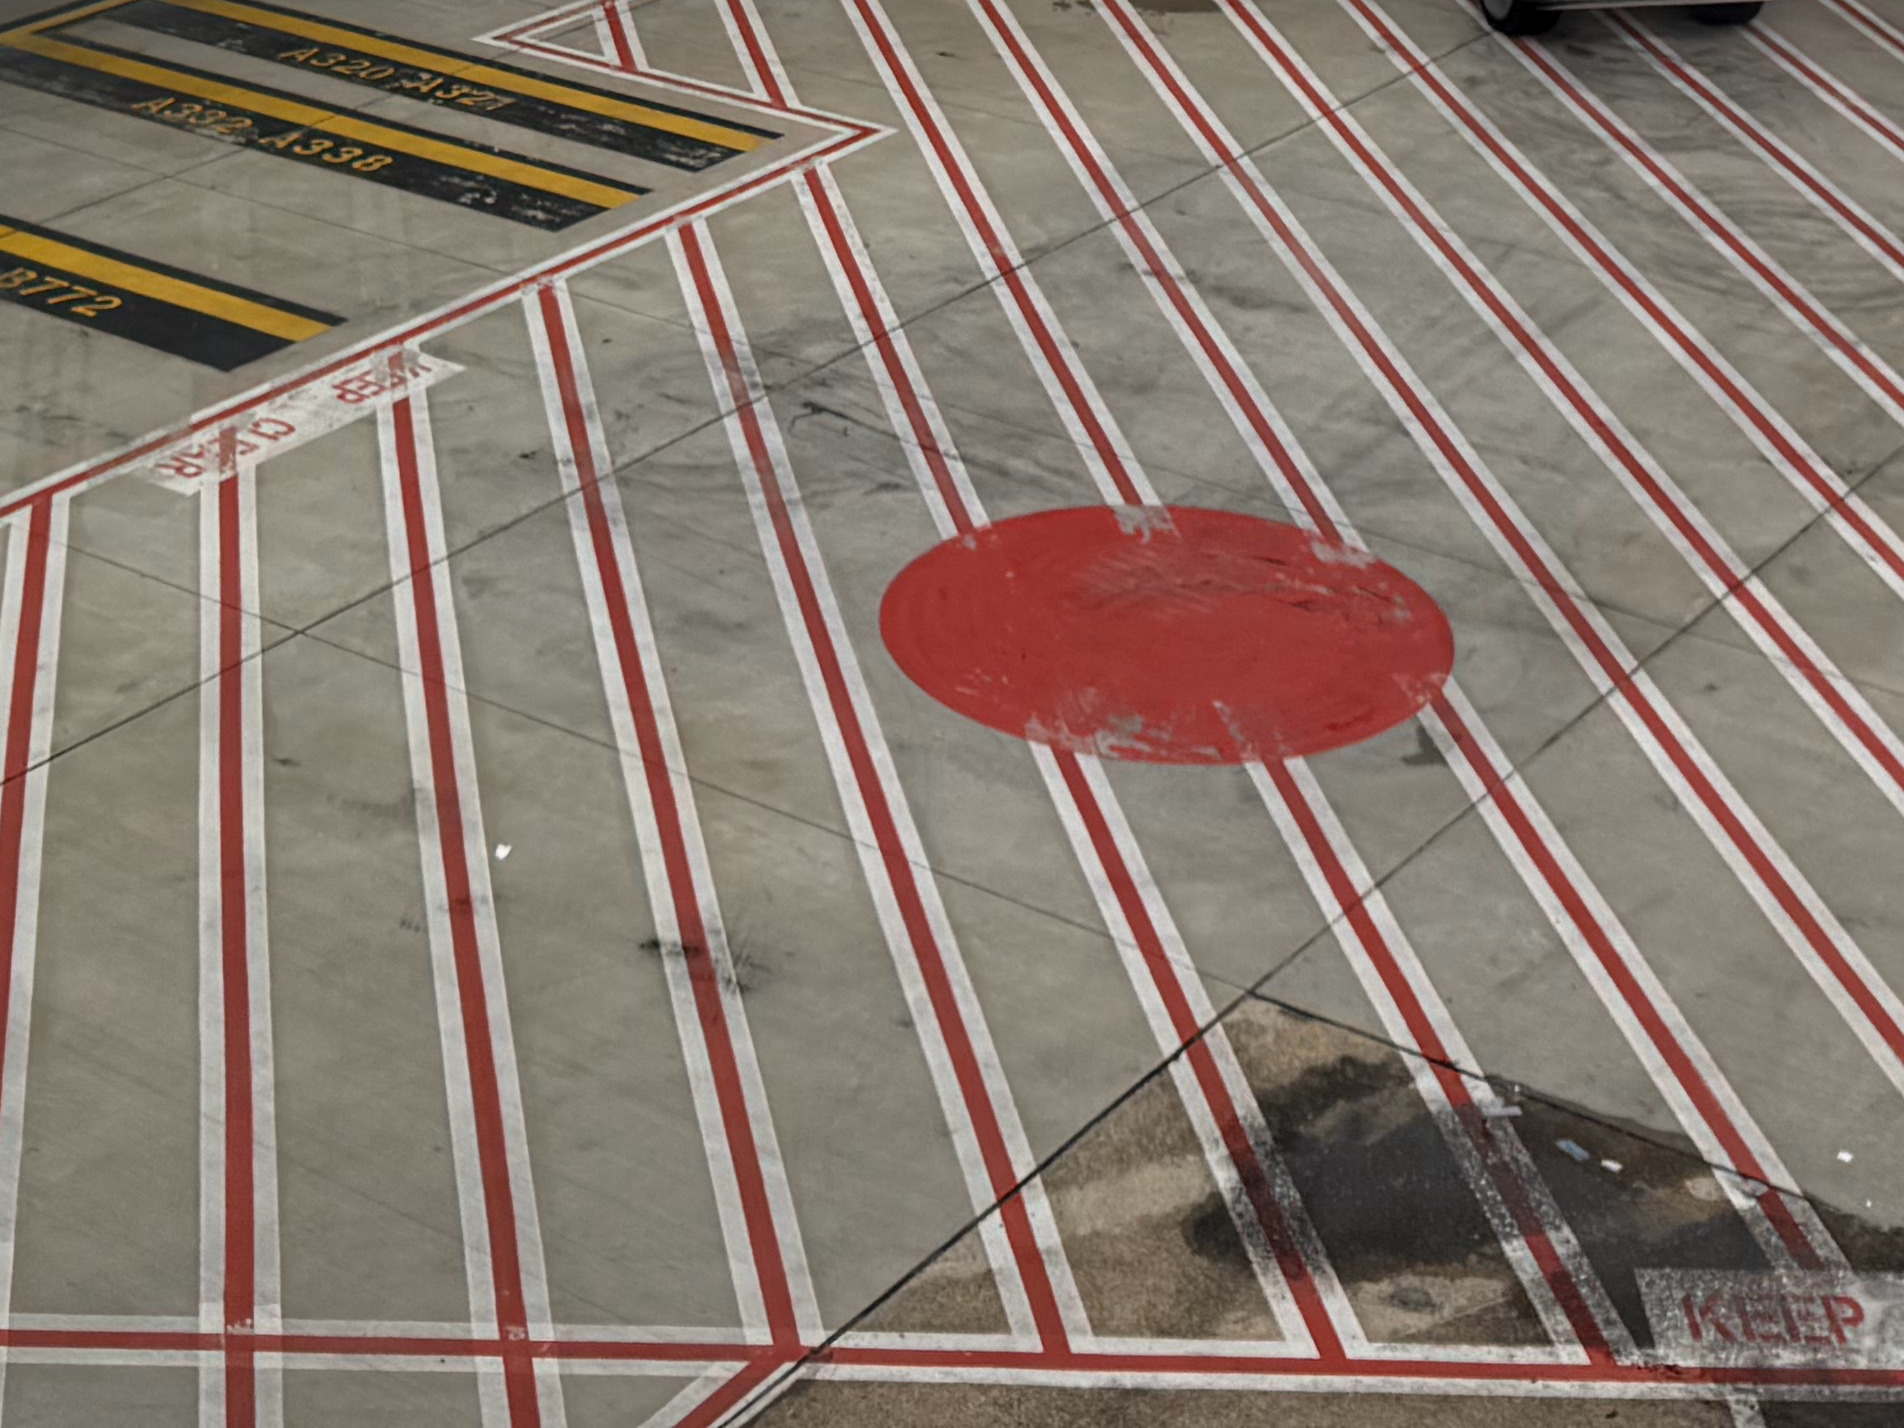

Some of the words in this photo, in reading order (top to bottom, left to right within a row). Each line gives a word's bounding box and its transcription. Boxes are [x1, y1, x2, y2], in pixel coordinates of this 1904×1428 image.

[278, 47, 396, 81] A320
[130, 97, 253, 134] A332
[257, 127, 394, 172] A338
[1681, 1292, 1865, 1345] KEEP
